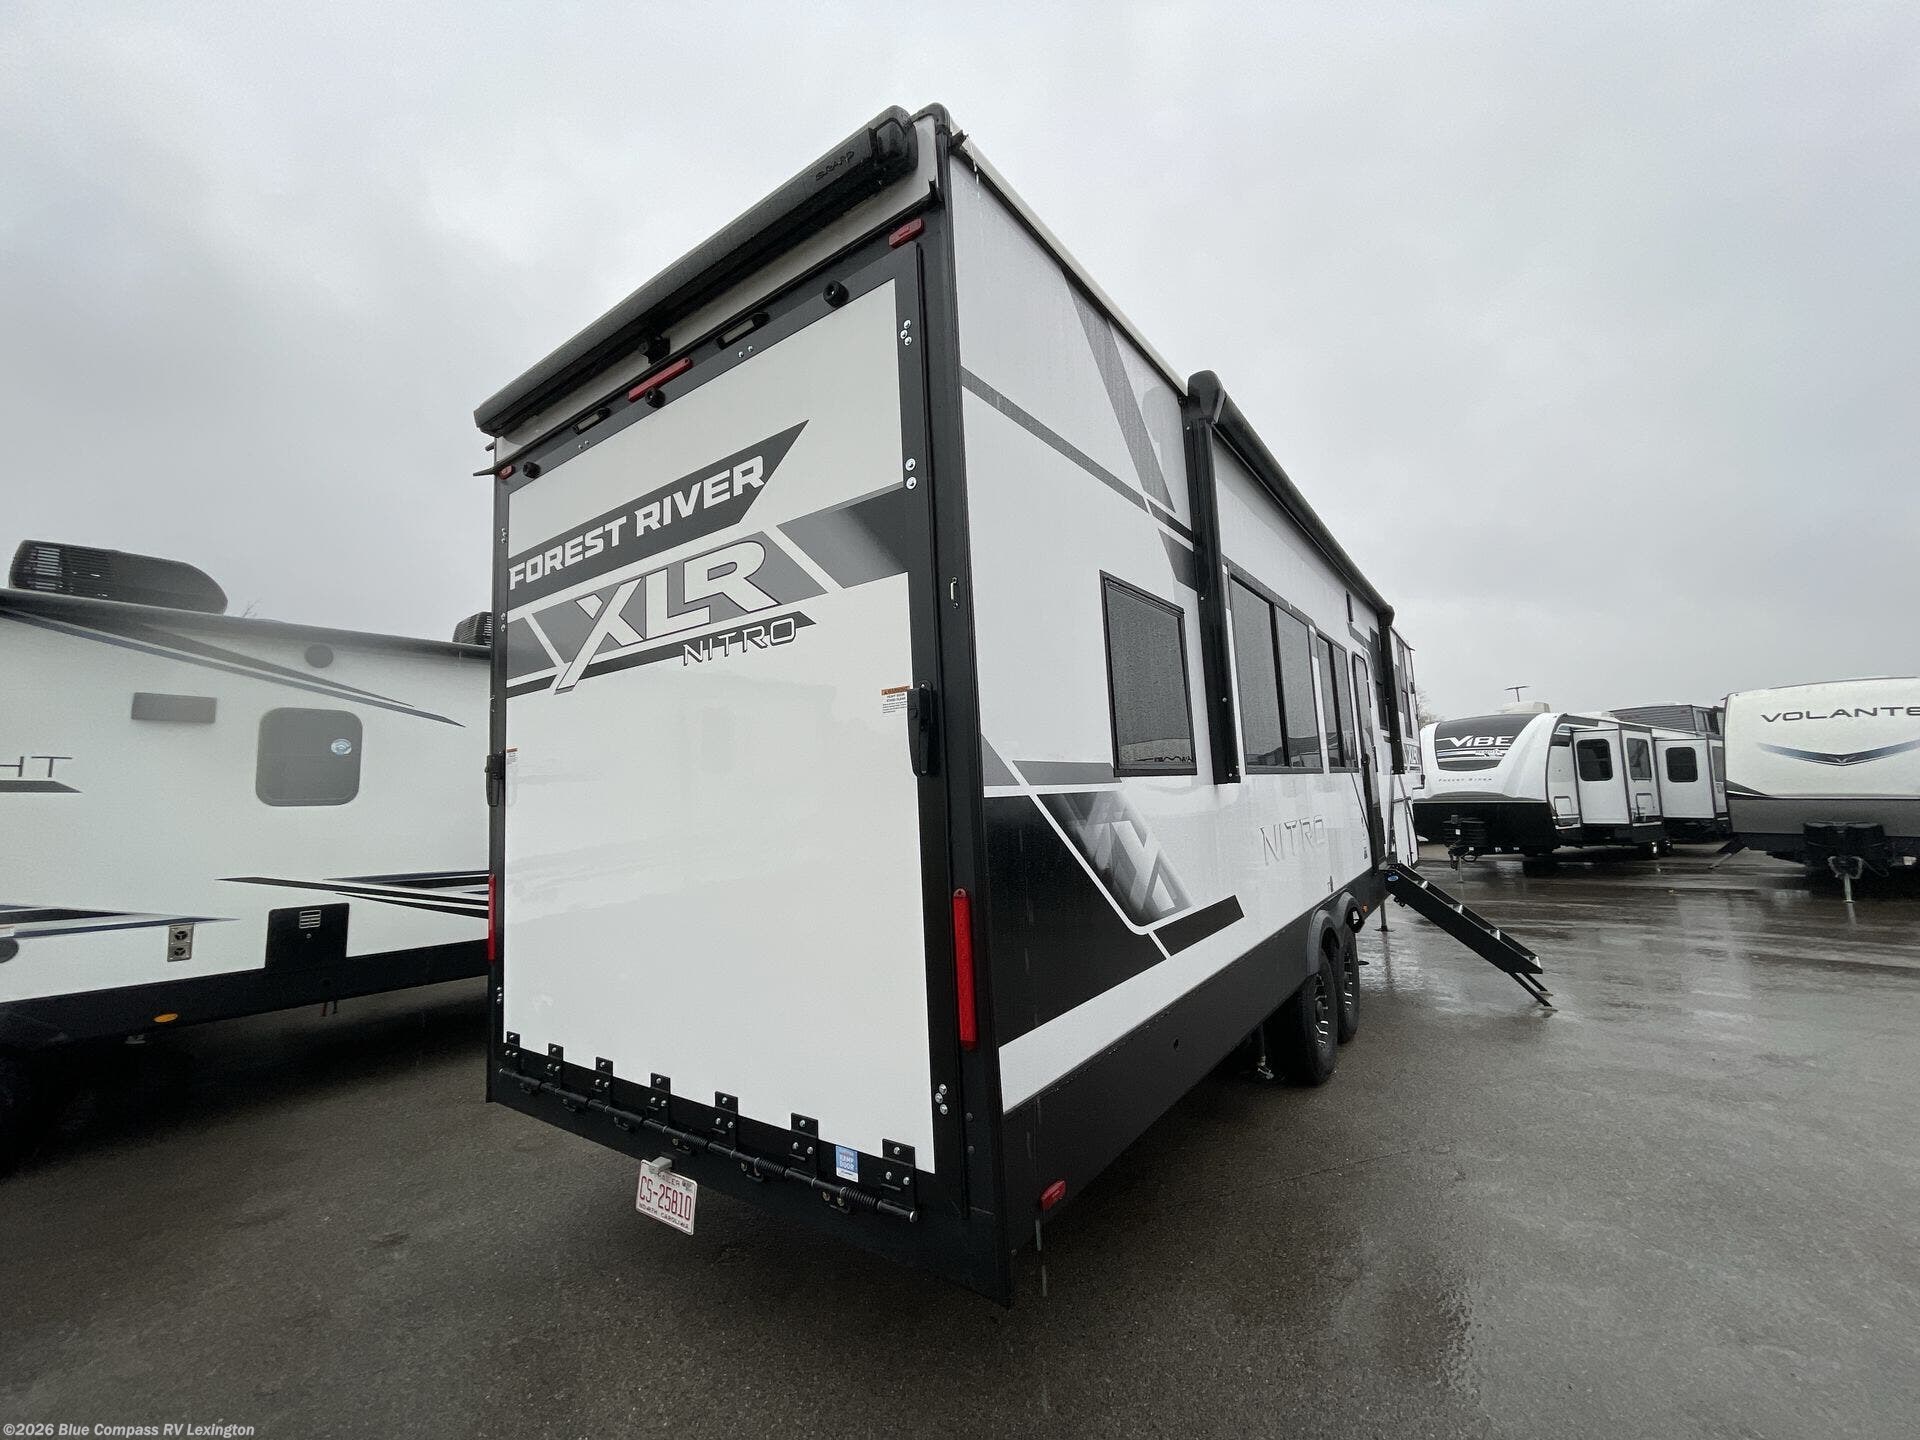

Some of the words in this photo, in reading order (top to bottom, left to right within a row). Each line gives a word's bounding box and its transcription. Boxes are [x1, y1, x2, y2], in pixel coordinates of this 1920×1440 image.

[509, 515, 627, 591] FOREST
[634, 455, 765, 537] RIVER
[555, 540, 782, 694] XLR
[682, 616, 797, 667] NITRO
[1760, 706, 1920, 723] VOLANTE
[1442, 735, 1515, 747] VIBE
[1259, 815, 1326, 866] NITRO
